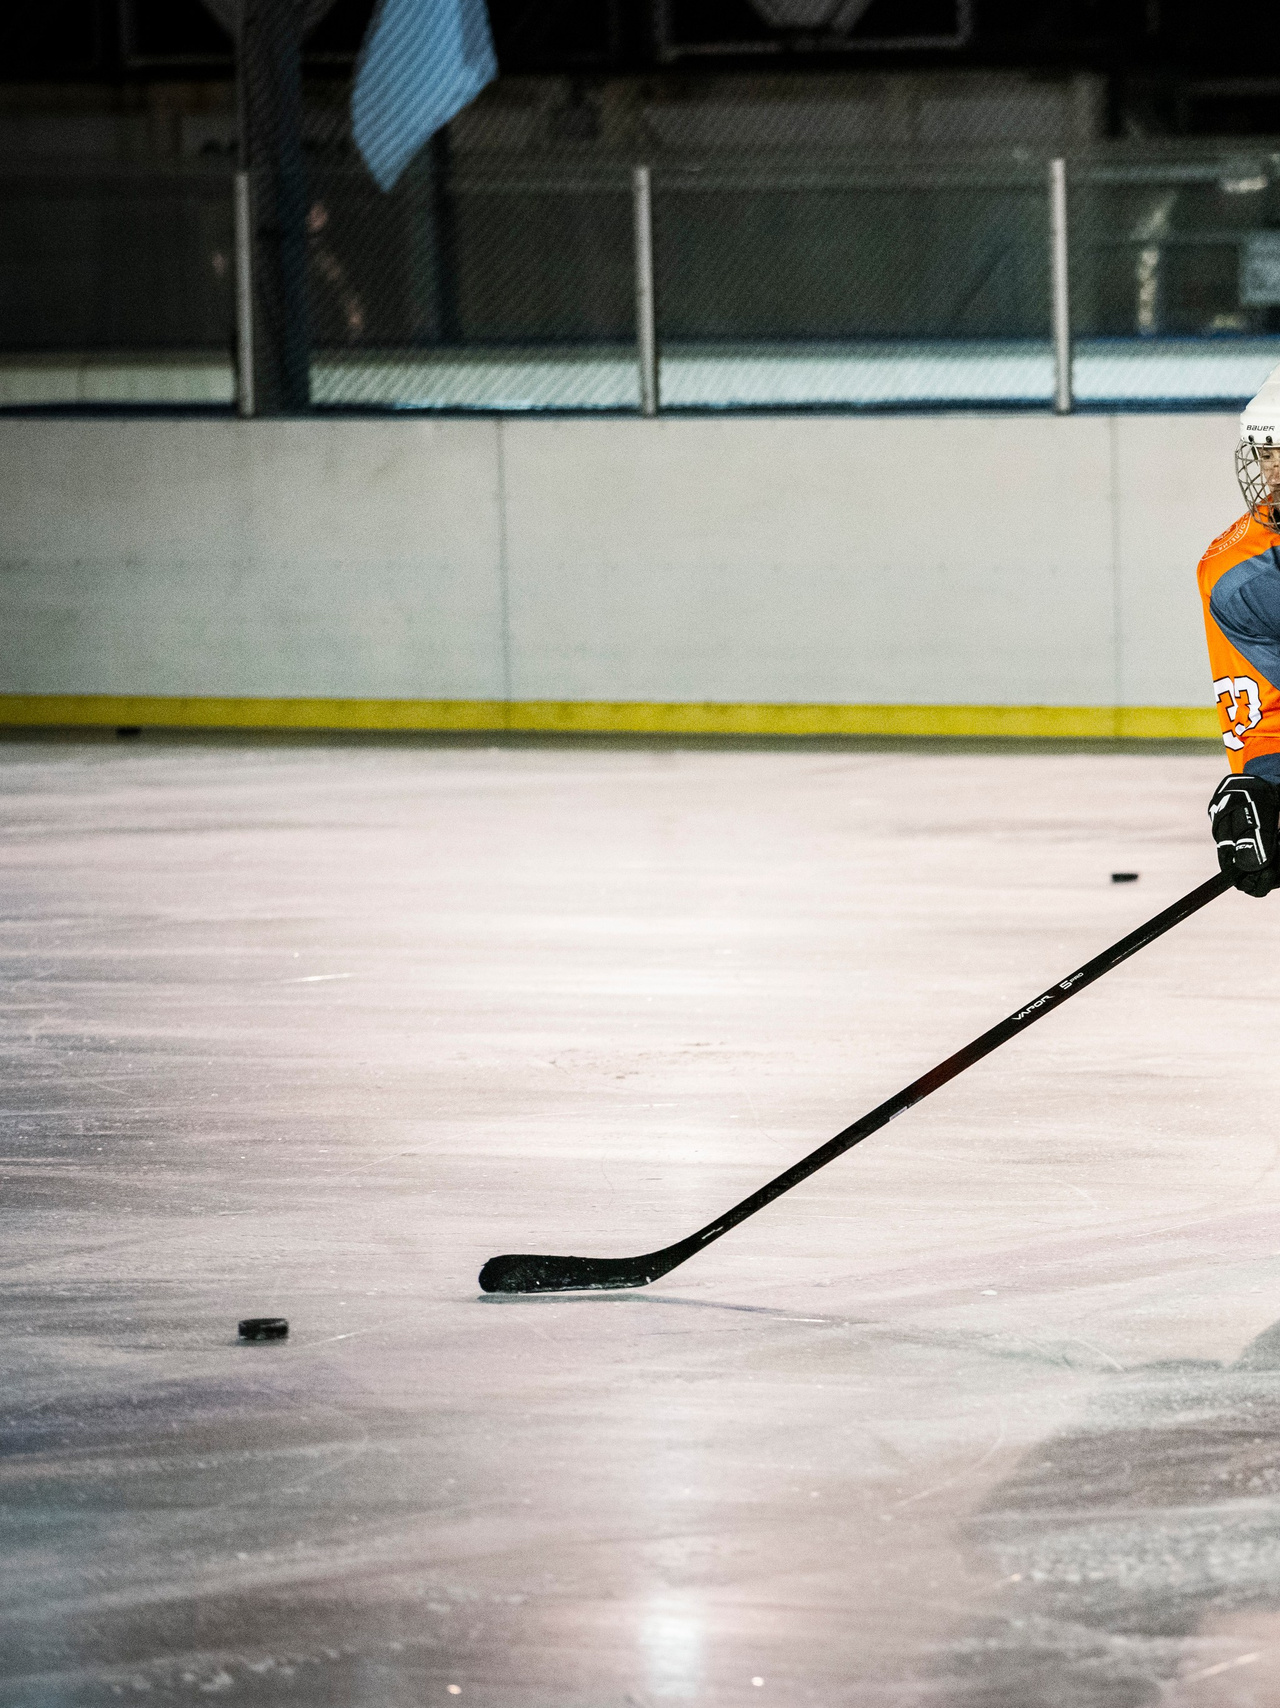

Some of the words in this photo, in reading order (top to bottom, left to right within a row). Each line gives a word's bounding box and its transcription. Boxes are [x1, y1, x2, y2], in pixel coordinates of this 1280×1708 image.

[1246, 424, 1275, 432] BAUER
[1213, 676, 1263, 752] 33
[1011, 995, 1055, 1020] VAPOR
